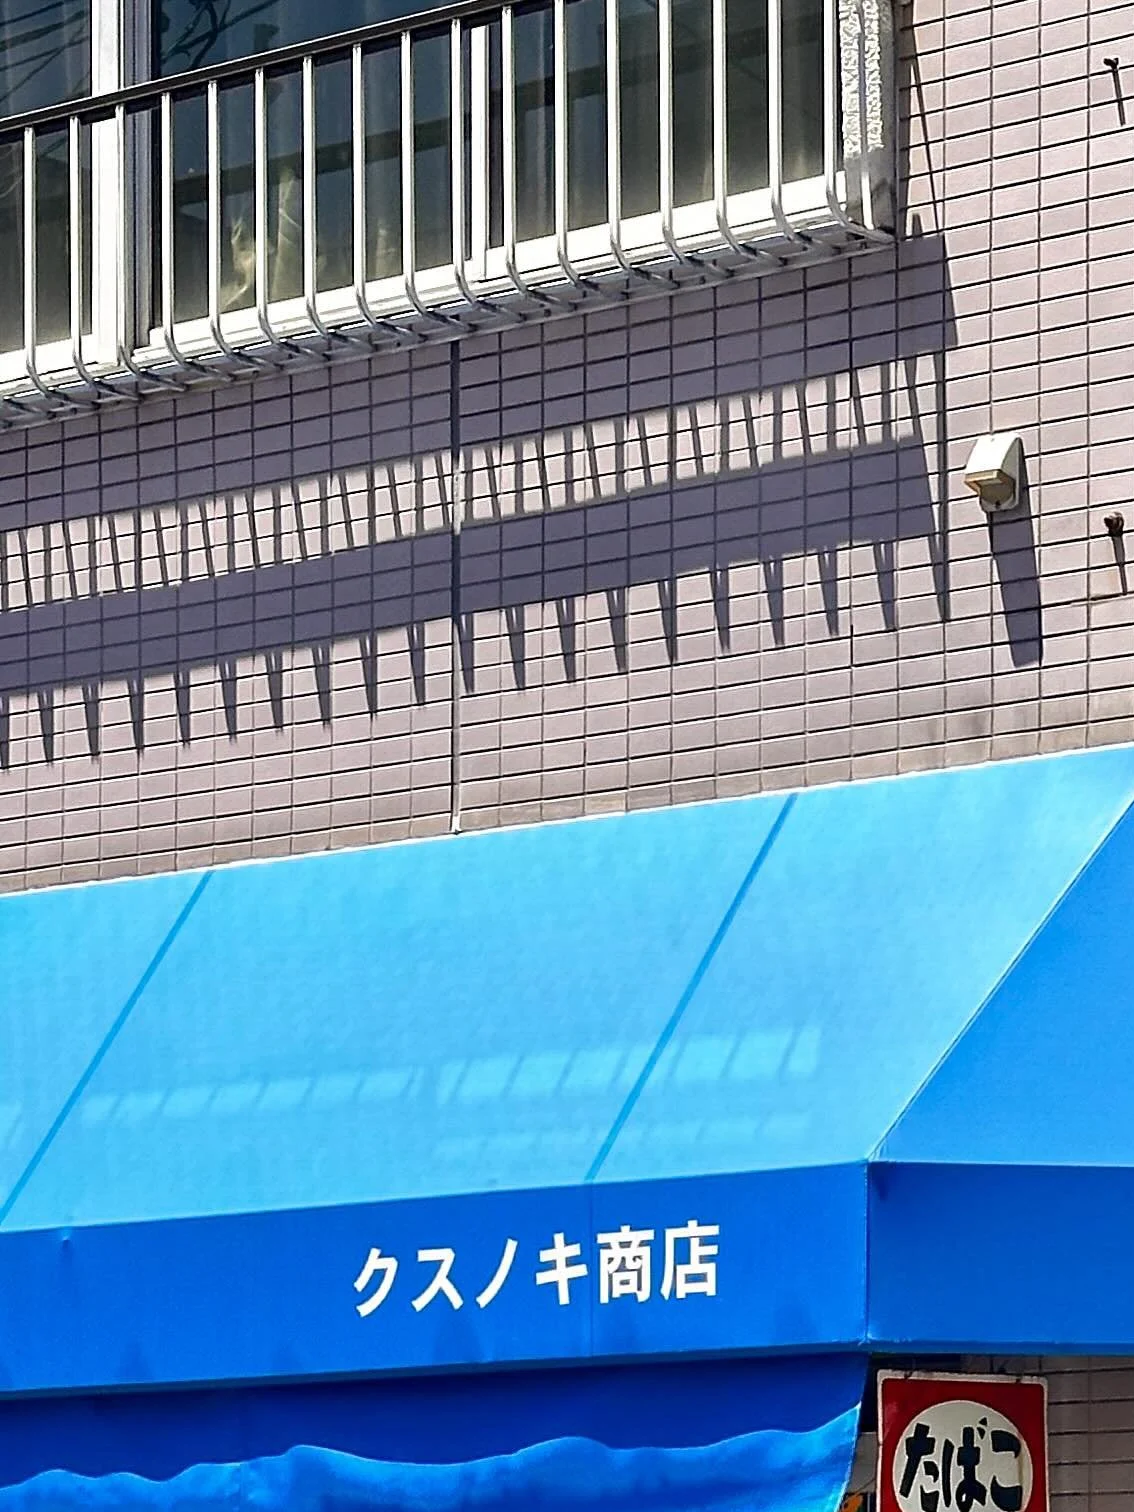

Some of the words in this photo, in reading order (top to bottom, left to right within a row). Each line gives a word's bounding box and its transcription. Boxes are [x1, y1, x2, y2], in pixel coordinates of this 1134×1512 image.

[353, 1219, 721, 1318] クスノキ商店
